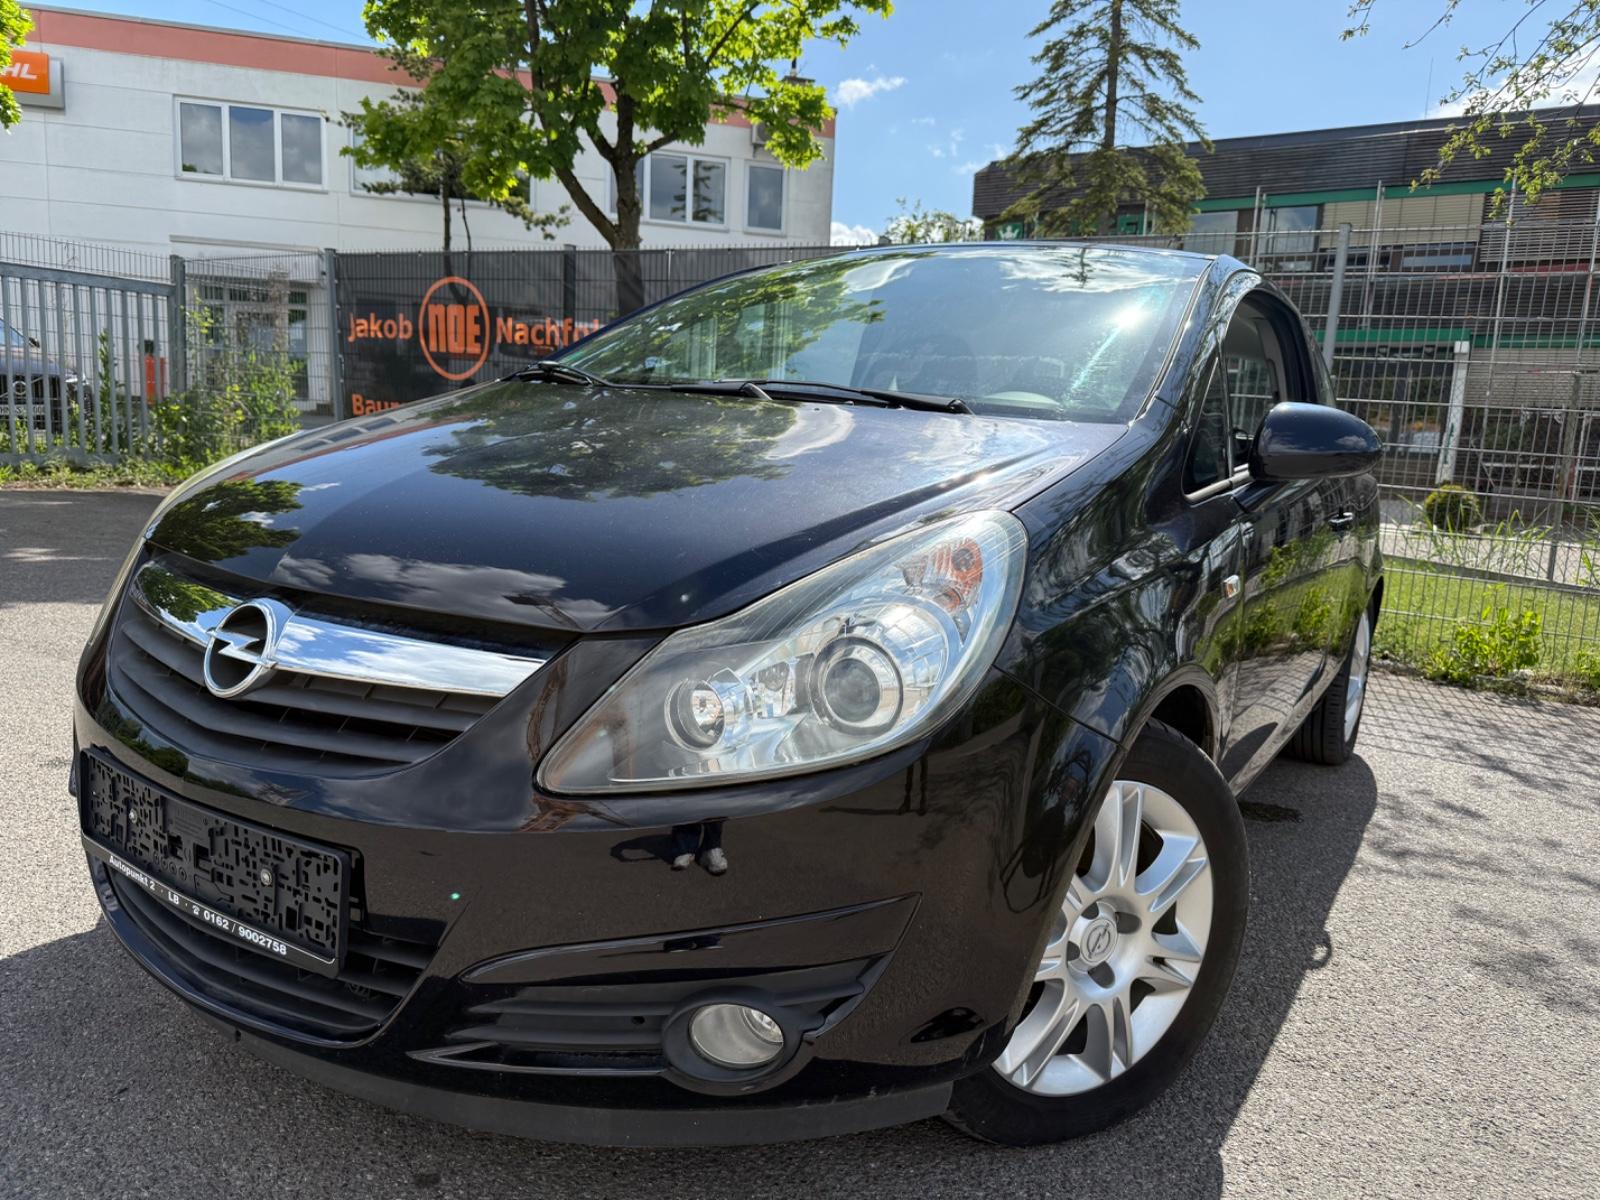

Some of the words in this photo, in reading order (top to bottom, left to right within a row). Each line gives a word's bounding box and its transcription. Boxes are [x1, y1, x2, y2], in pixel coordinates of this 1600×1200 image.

[109, 855, 150, 888] Autopunkt
[149, 881, 156, 891] 2
[168, 891, 180, 905] LB
[203, 910, 230, 930] 0162
[238, 926, 287, 956] 9002758
